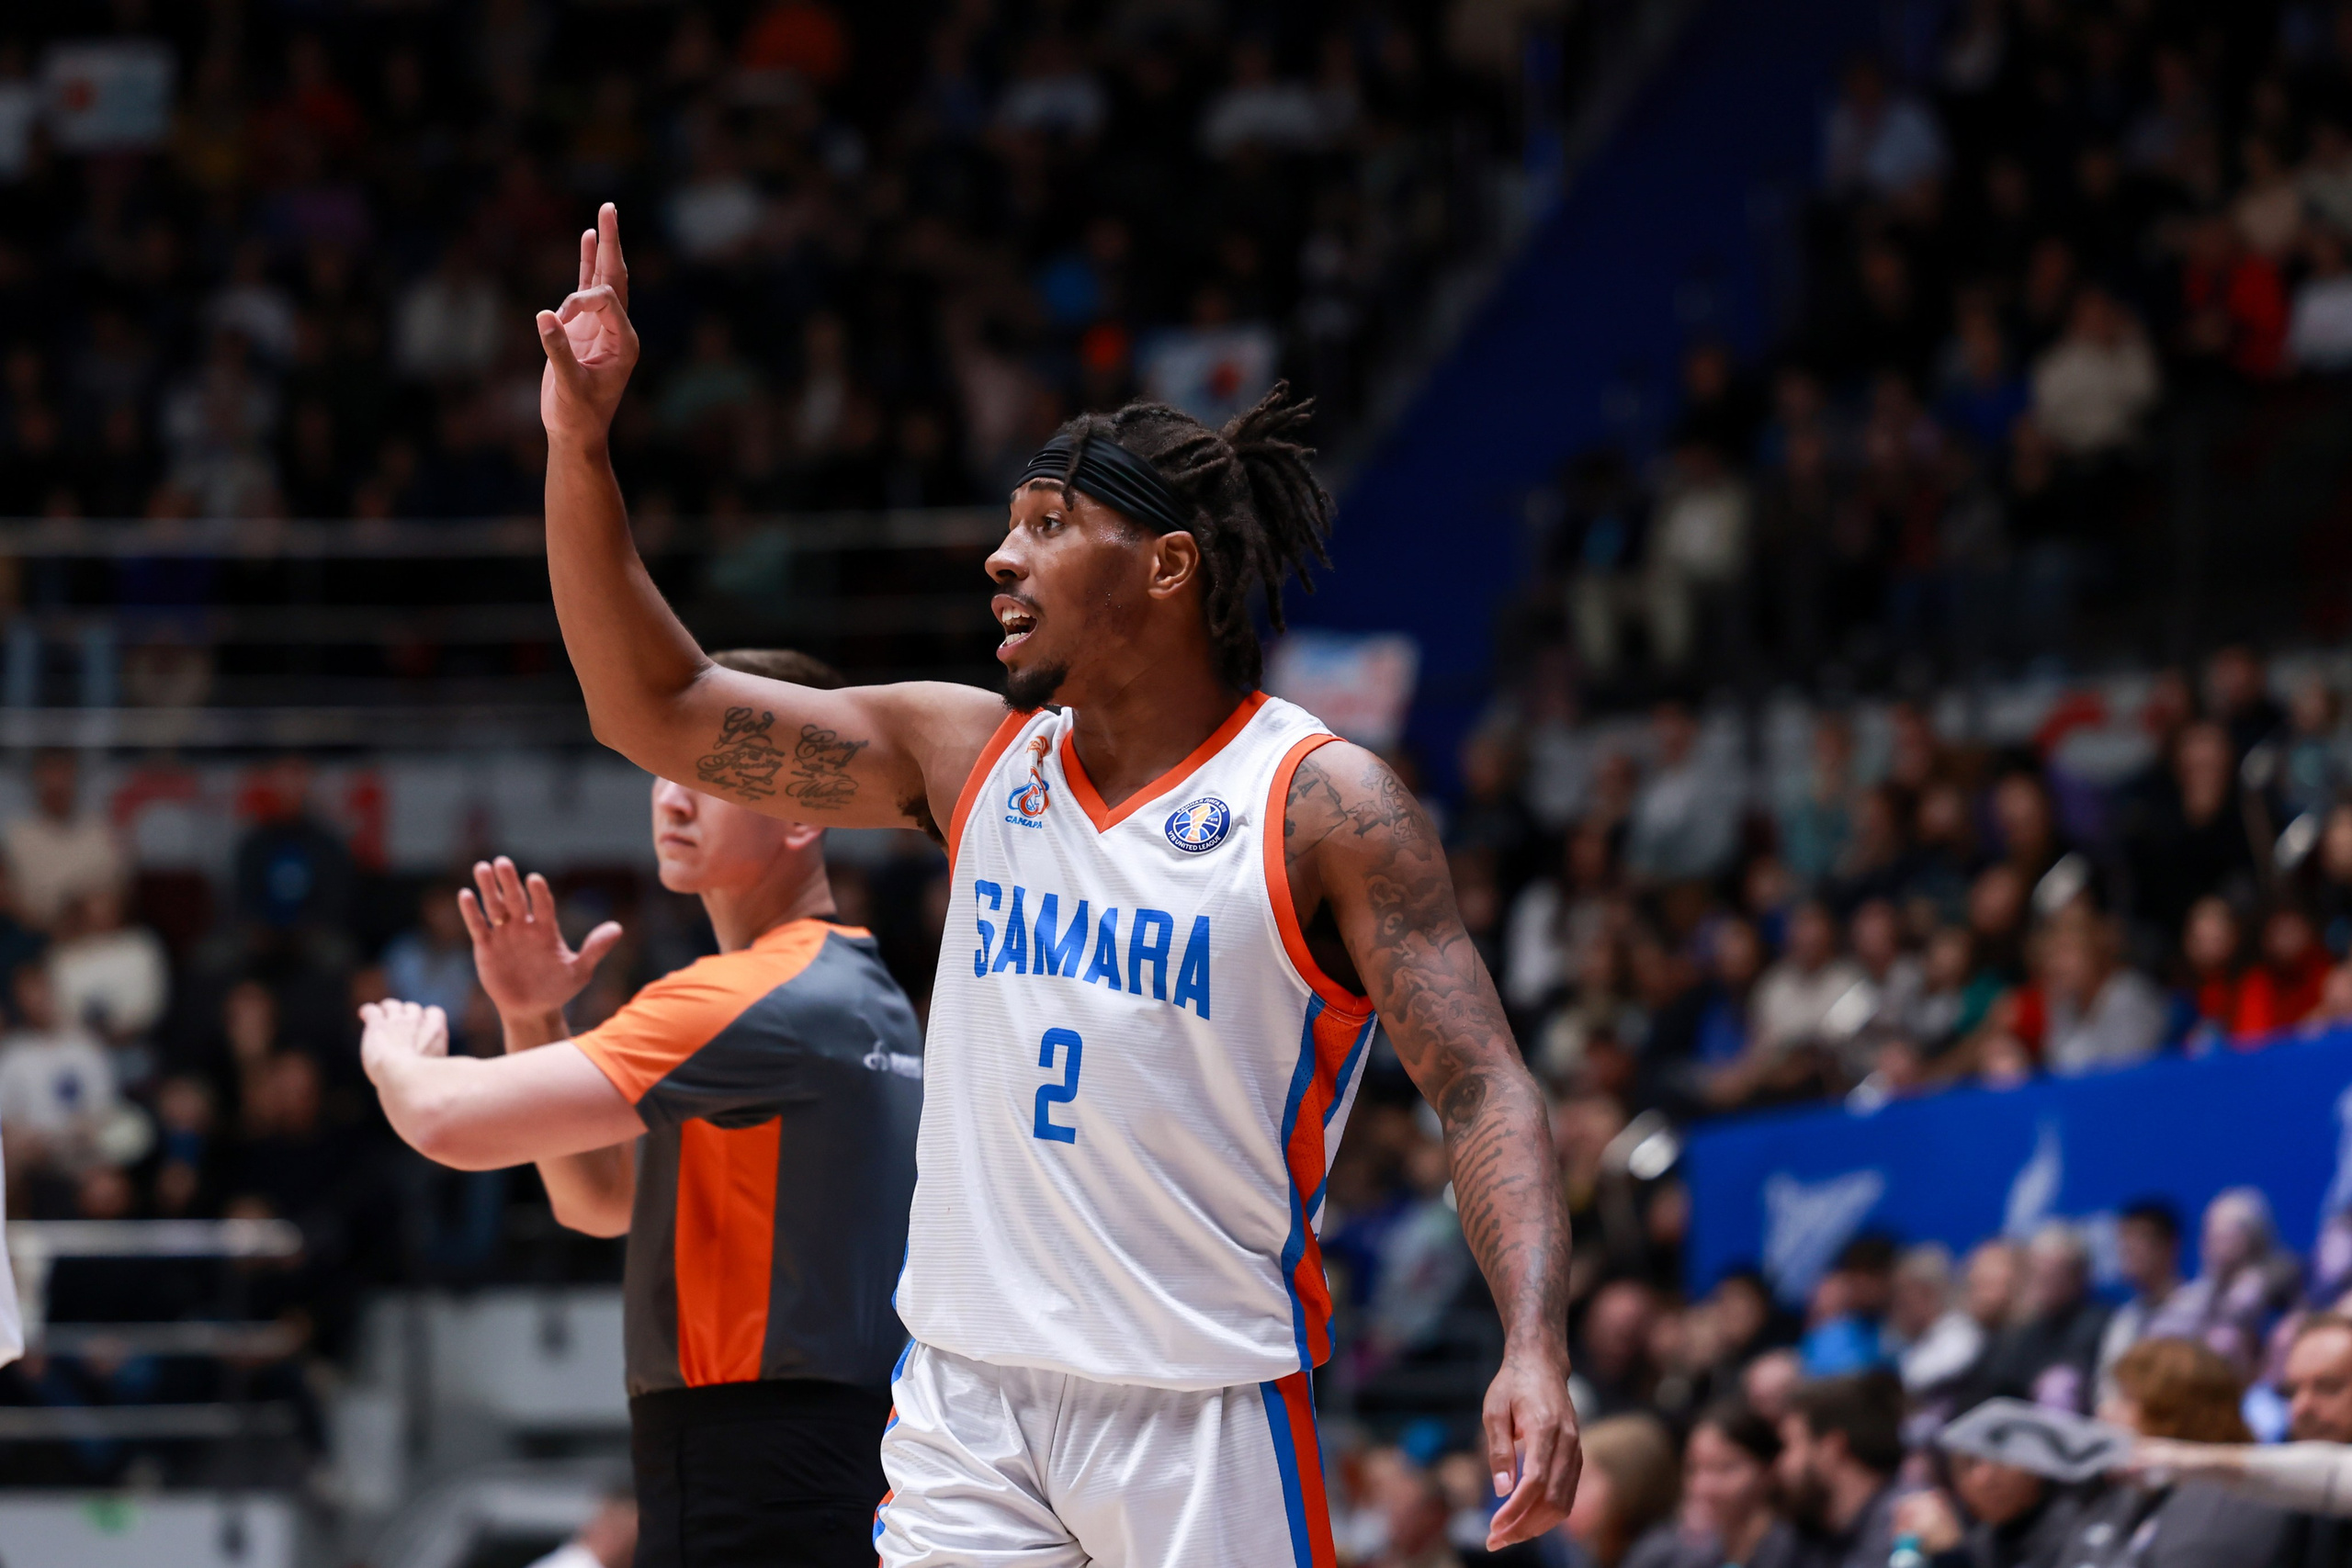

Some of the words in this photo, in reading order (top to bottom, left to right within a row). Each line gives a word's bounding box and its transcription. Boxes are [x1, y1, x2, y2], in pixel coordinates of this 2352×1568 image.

[1004, 815, 1043, 829] САМАРА
[1175, 839, 1198, 851] UNITED
[1198, 835, 1221, 851] LEAGUE
[974, 879, 1211, 1021] SAMARA
[1033, 1027, 1083, 1145] 2
